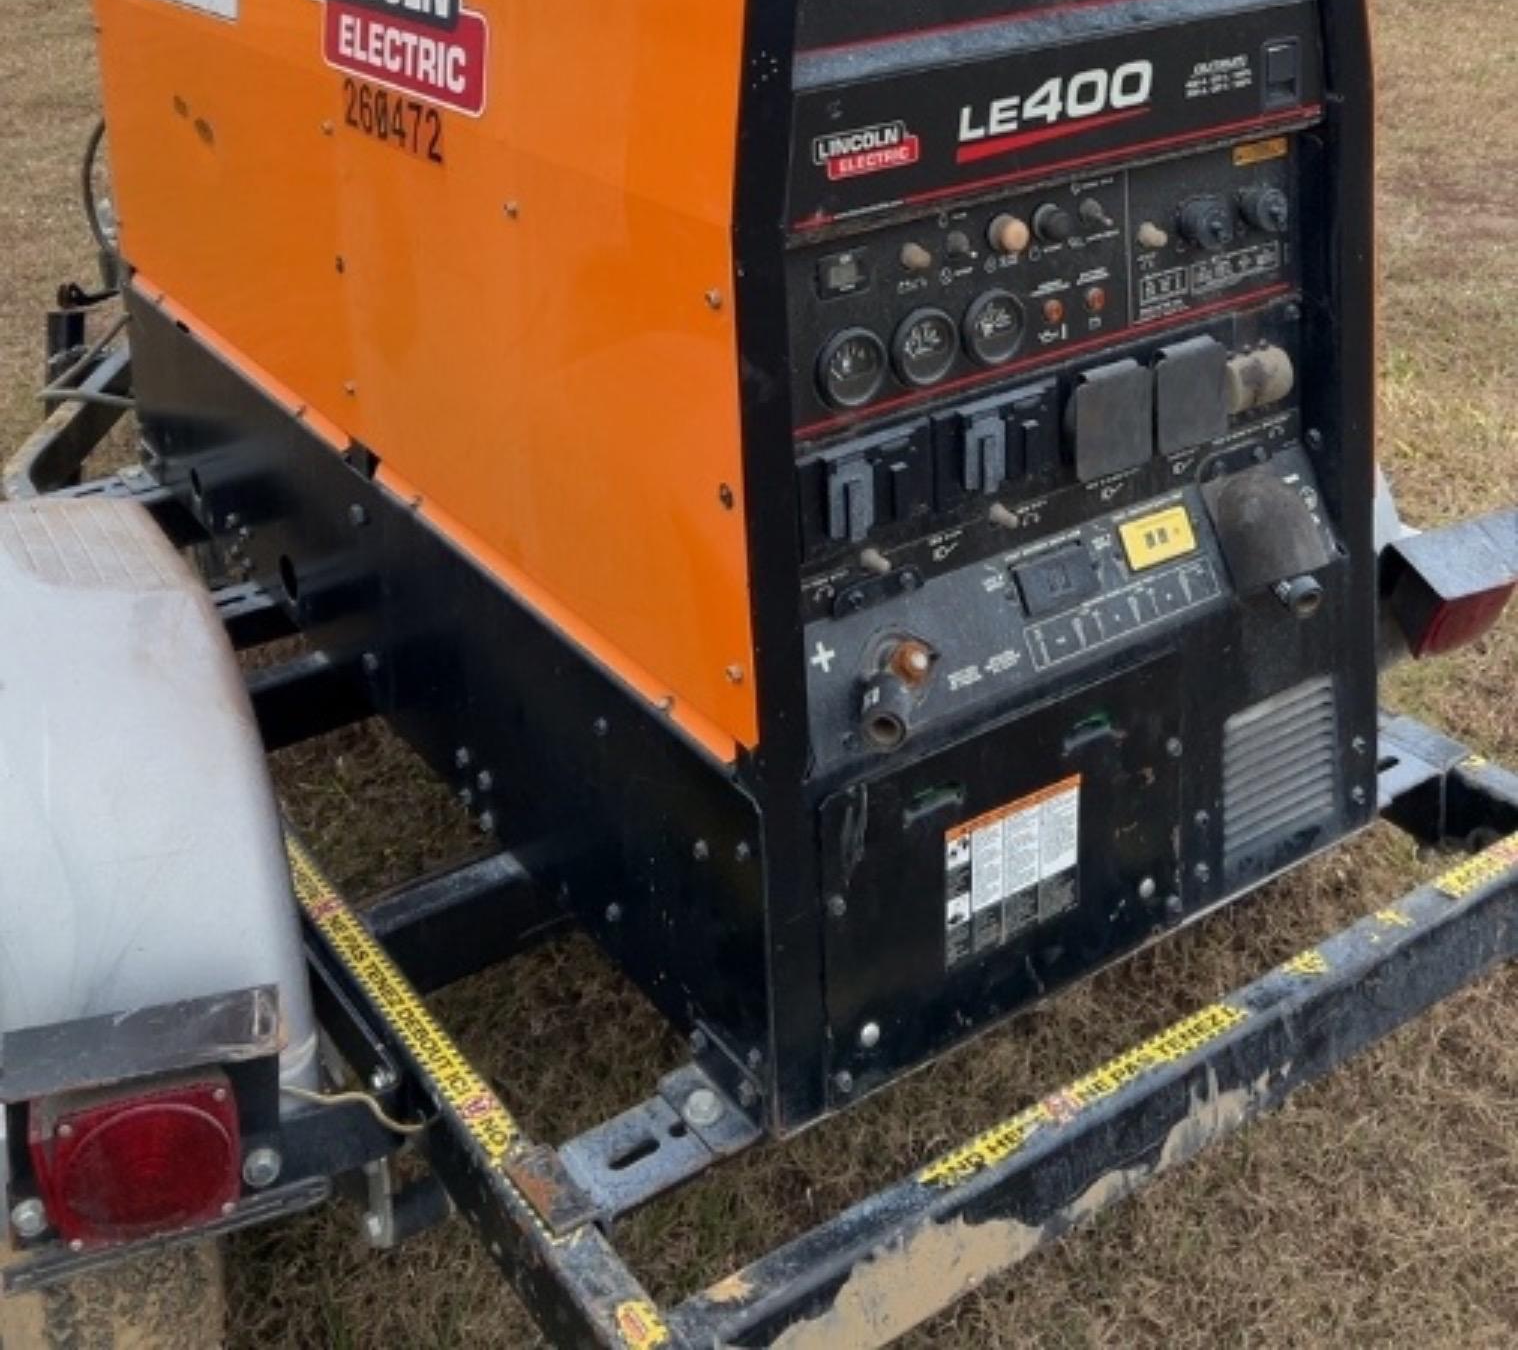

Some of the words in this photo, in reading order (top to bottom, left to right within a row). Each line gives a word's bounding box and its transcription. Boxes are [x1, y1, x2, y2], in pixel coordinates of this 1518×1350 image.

[338, 14, 467, 95] ELECTRIC
[343, 77, 444, 166] 260472
[958, 59, 1153, 141] LE400
[818, 127, 899, 160] LINCOLN
[839, 146, 910, 171] ELECTRIC
[398, 1007, 455, 1077] DEBOUT
[478, 1118, 508, 1146] NO
